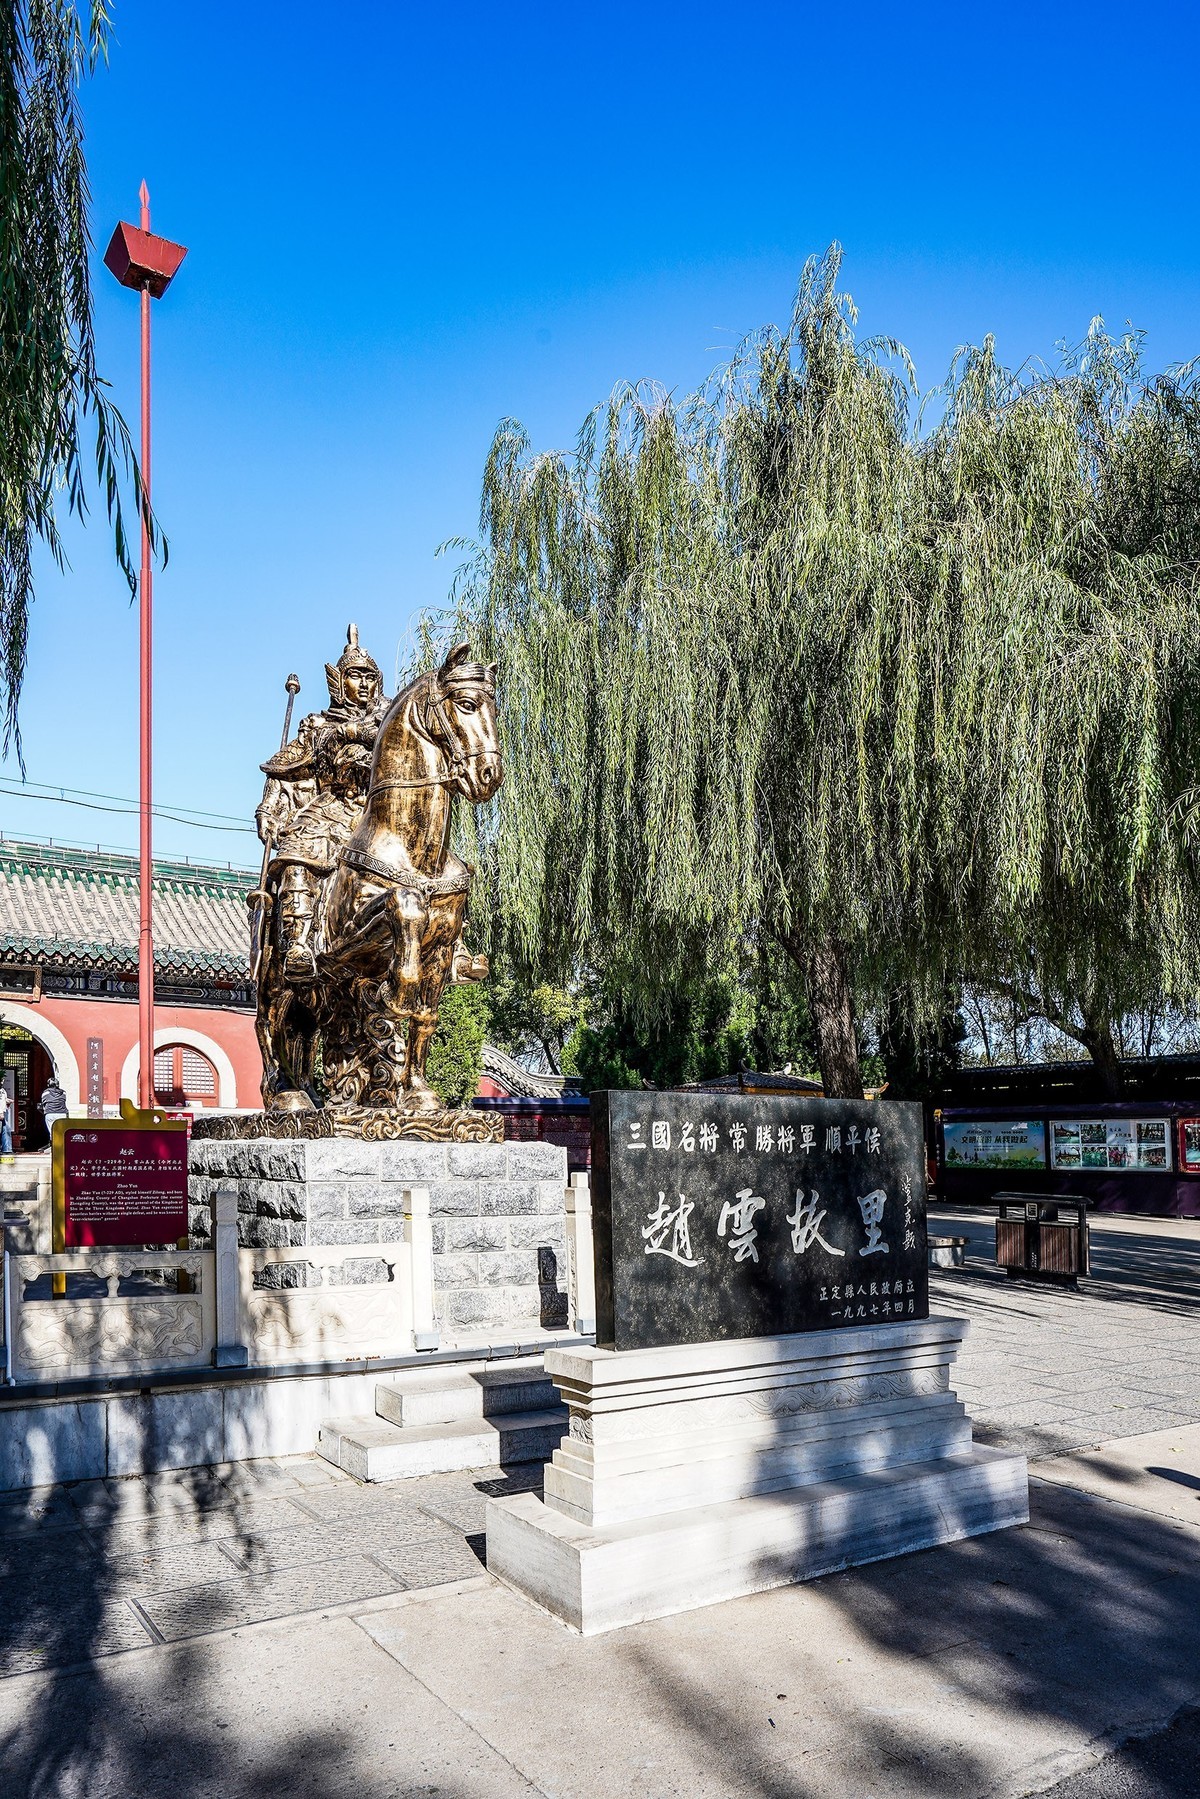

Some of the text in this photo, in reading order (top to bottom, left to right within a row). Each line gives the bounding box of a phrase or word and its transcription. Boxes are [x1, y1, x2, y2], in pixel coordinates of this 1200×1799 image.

[627, 1121, 882, 1155] 三國名將 常勝將軍 順平侯
[119, 1148, 135, 1156] 赵云
[642, 1188, 889, 1267] 趙雲故里
[831, 1299, 915, 1319] 一九九七年四月
